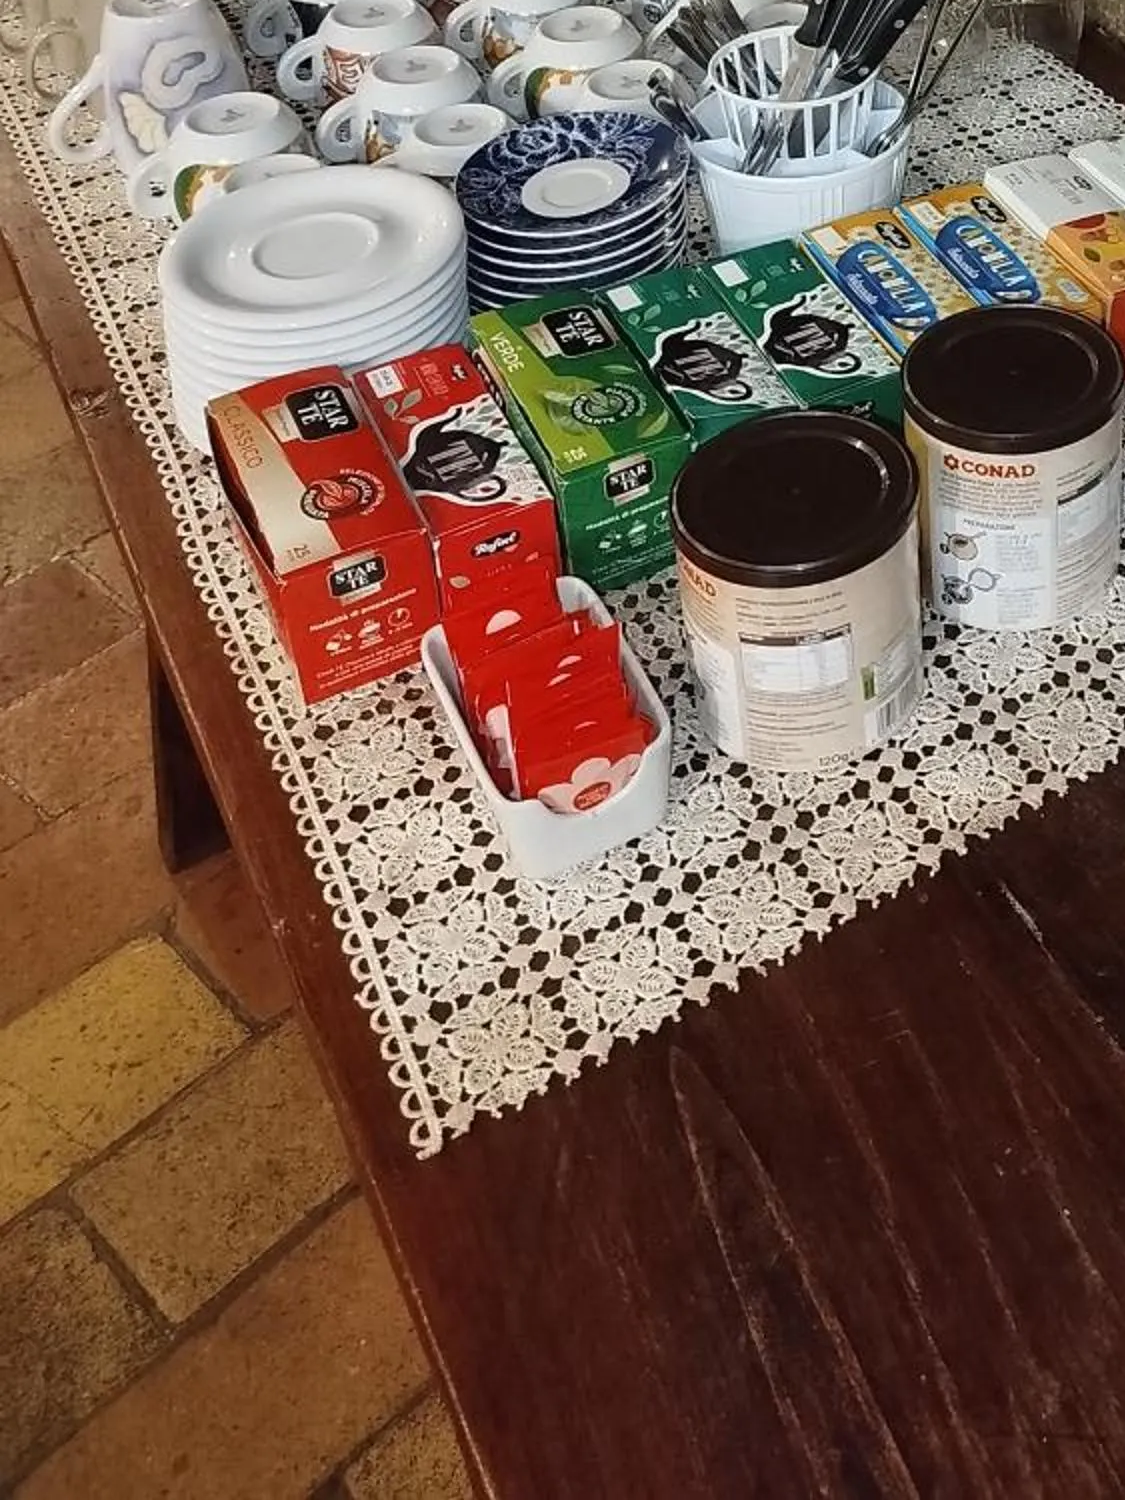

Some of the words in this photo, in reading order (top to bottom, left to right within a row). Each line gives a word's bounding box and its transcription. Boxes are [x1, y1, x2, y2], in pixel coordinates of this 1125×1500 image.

[568, 311, 605, 346] STAR
[490, 331, 525, 373] VERDE
[313, 387, 349, 429] STAR
[222, 404, 264, 469] CLASSICO
[609, 463, 647, 487] STAR
[961, 460, 1035, 478] CONAD
[334, 560, 378, 583] STAR
